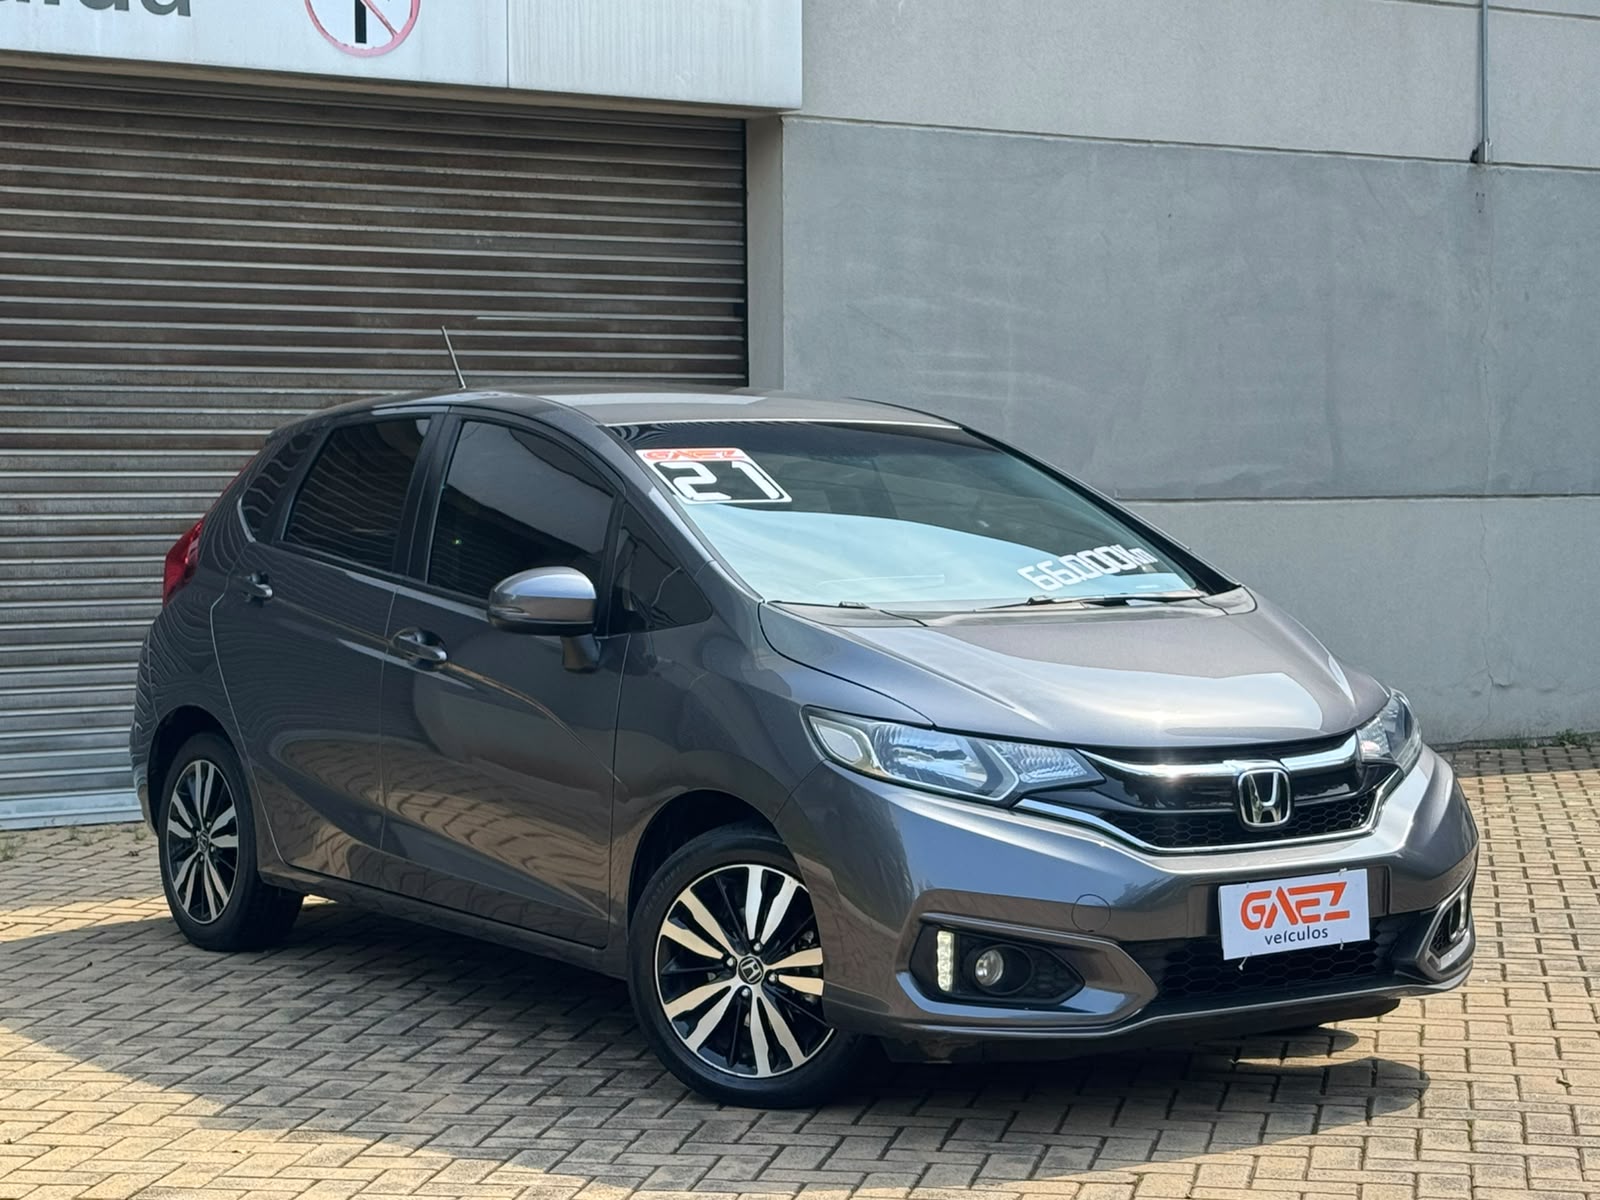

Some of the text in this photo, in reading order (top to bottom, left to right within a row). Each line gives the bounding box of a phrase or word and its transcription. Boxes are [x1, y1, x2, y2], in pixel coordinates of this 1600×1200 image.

[659, 461, 780, 500] 21
[1240, 881, 1350, 930] GAEZ
[1265, 926, 1329, 945] veículos
